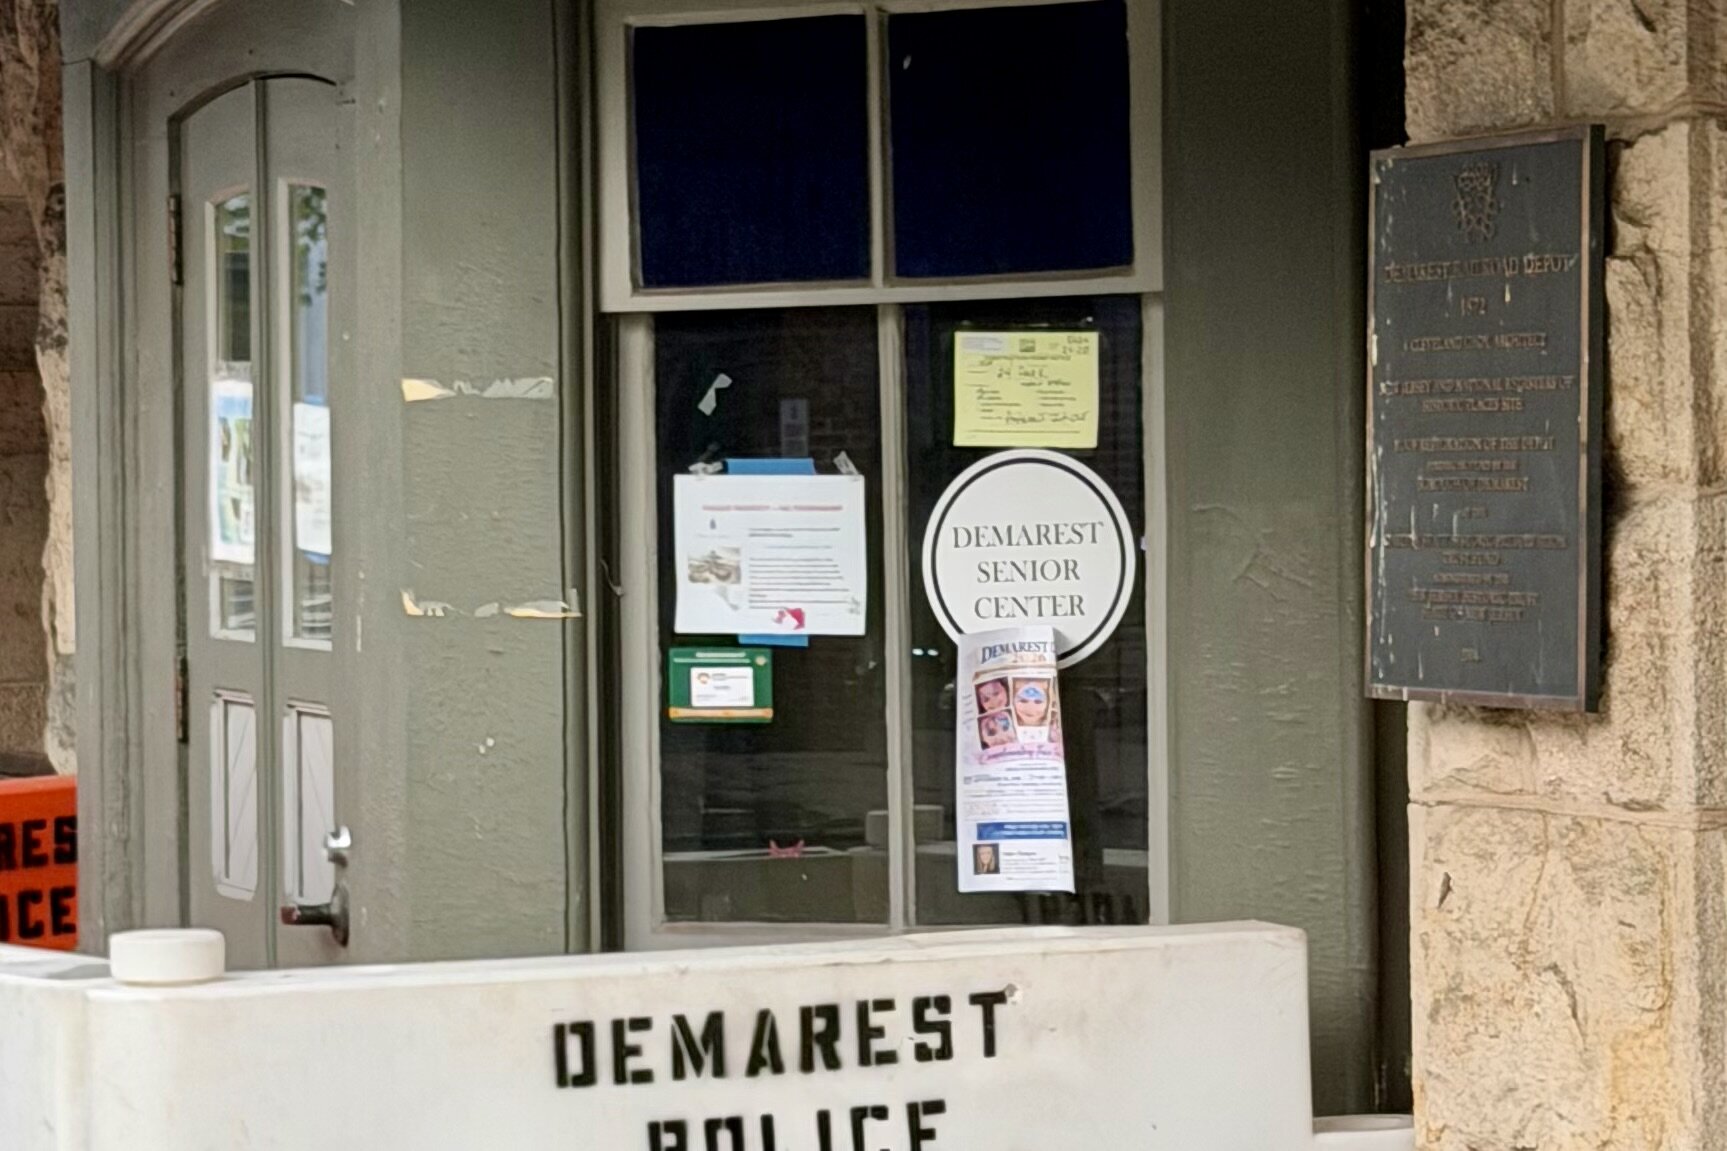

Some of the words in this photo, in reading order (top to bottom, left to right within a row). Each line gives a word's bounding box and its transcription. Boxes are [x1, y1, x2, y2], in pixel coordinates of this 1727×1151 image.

[1523, 253, 1570, 275] DEPOT
[952, 521, 1102, 549] DEMAREST
[976, 559, 1080, 584] SENIOR
[974, 594, 1085, 619] CENTER
[981, 641, 1047, 664] DEMAREST
[553, 990, 1008, 1089] DEMAREST
